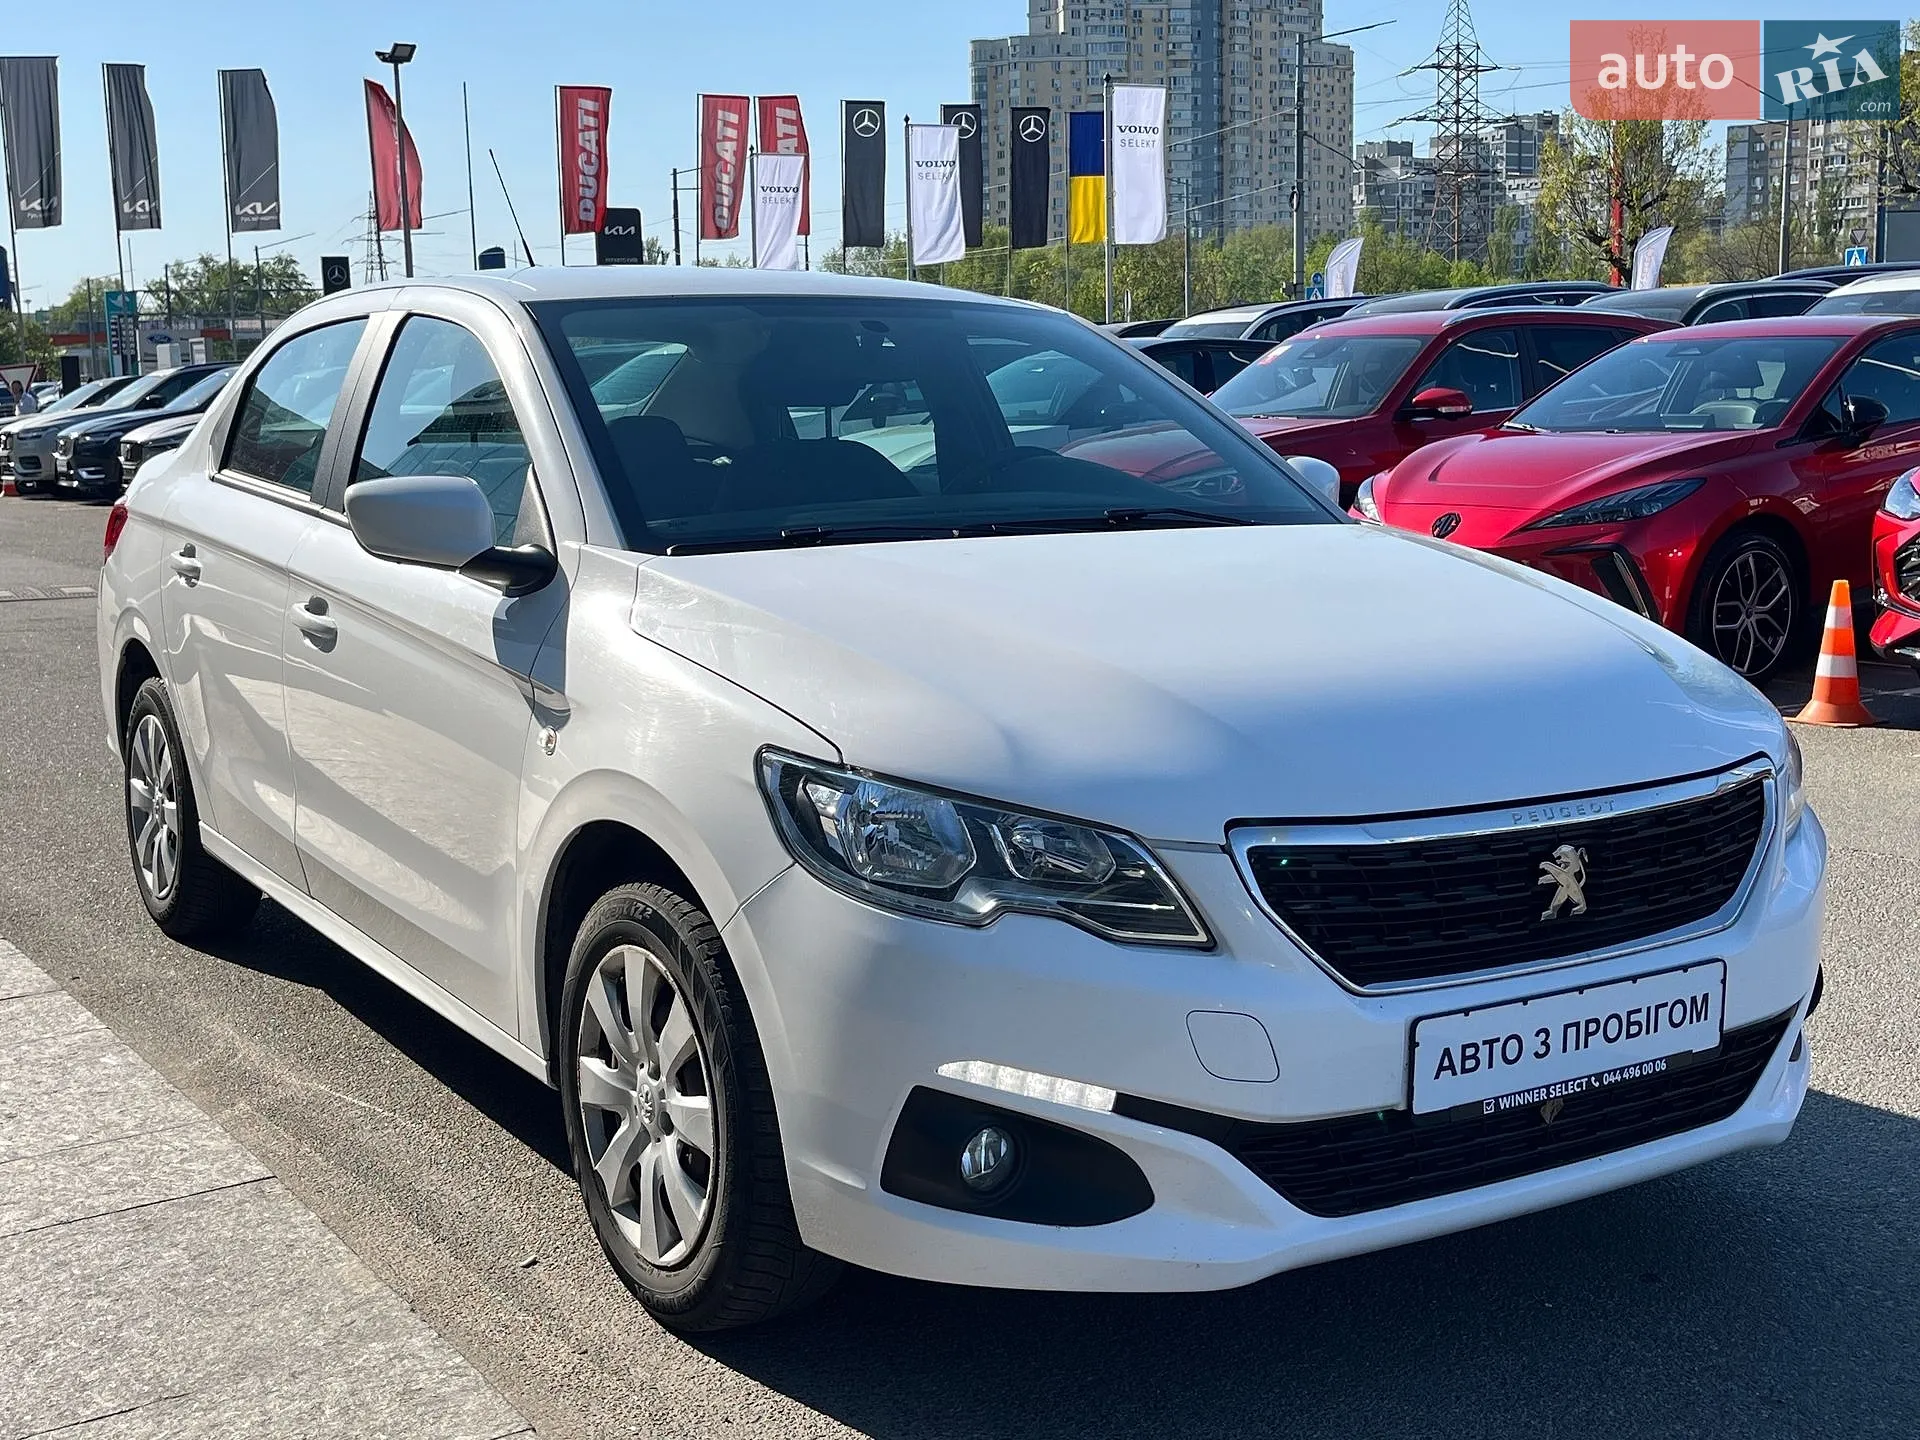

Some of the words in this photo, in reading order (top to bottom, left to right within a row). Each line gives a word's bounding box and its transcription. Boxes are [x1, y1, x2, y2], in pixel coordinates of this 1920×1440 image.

[775, 106, 798, 154] ATI
[1116, 124, 1160, 135] VOLVO
[1120, 138, 1156, 149] SELEKT
[577, 98, 600, 222] DUCATI
[714, 109, 739, 232] DUCATI
[915, 160, 956, 168] VOLVO
[760, 185, 800, 194] VOLVO
[761, 196, 798, 205] SELEKT
[1511, 799, 1616, 825] PEUGEOT
[1433, 1033, 1524, 1080] АВТО
[1532, 1027, 1551, 1059] З
[1561, 992, 1710, 1054] ПРОБІГОМ
[1498, 1088, 1548, 1110] WINNER
[1549, 1078, 1589, 1098] SELECT
[1602, 1070, 1622, 1085] 044
[1622, 1065, 1641, 1080] 496
[1642, 1061, 1654, 1075] 00
[1655, 1059, 1667, 1072] 06
